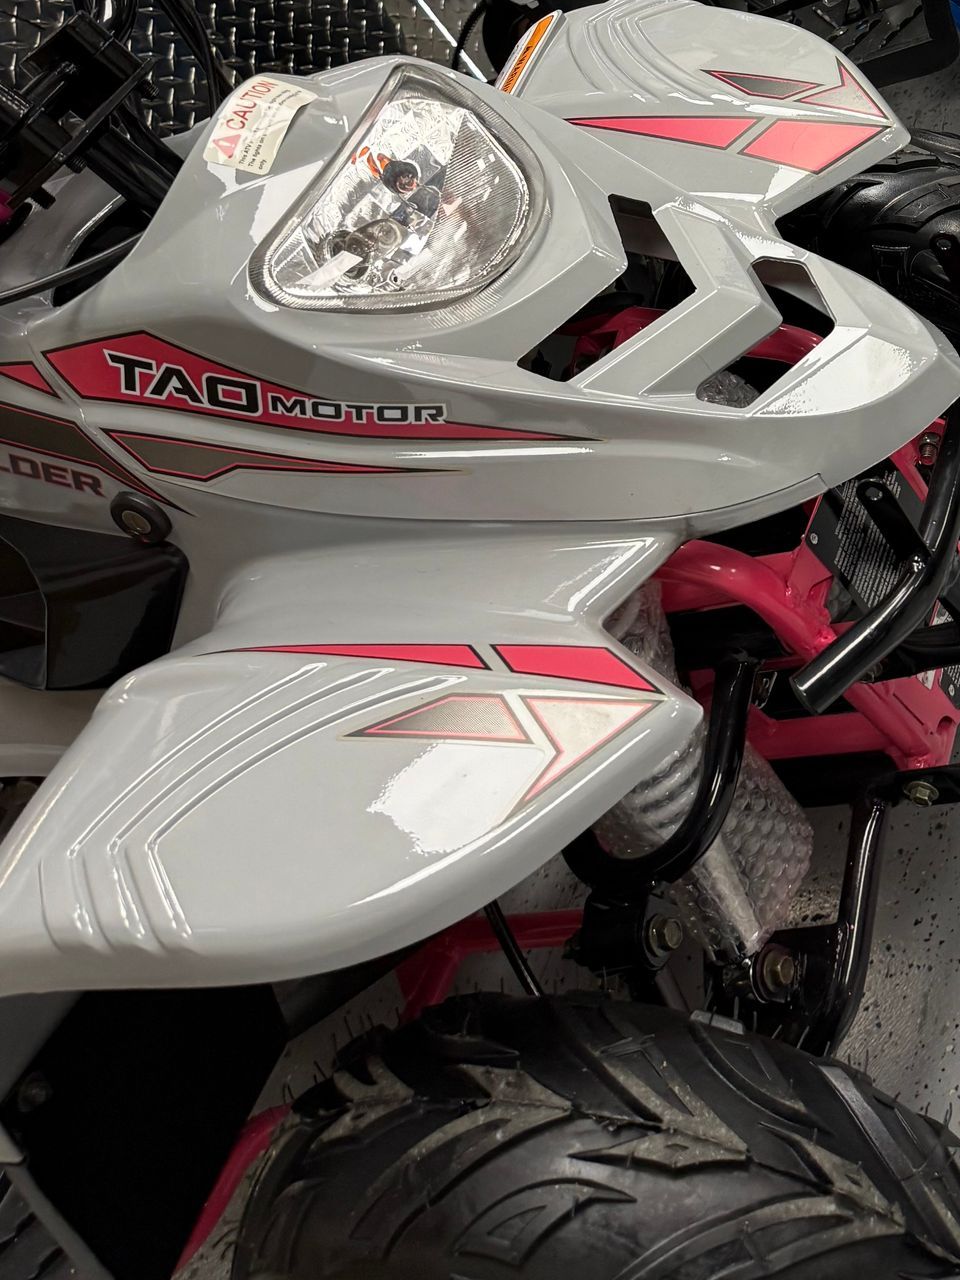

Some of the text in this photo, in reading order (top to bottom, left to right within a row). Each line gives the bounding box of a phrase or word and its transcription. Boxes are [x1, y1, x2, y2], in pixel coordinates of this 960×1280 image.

[226, 81, 278, 130] CAUTION
[103, 348, 449, 425] TAO MOTOR
